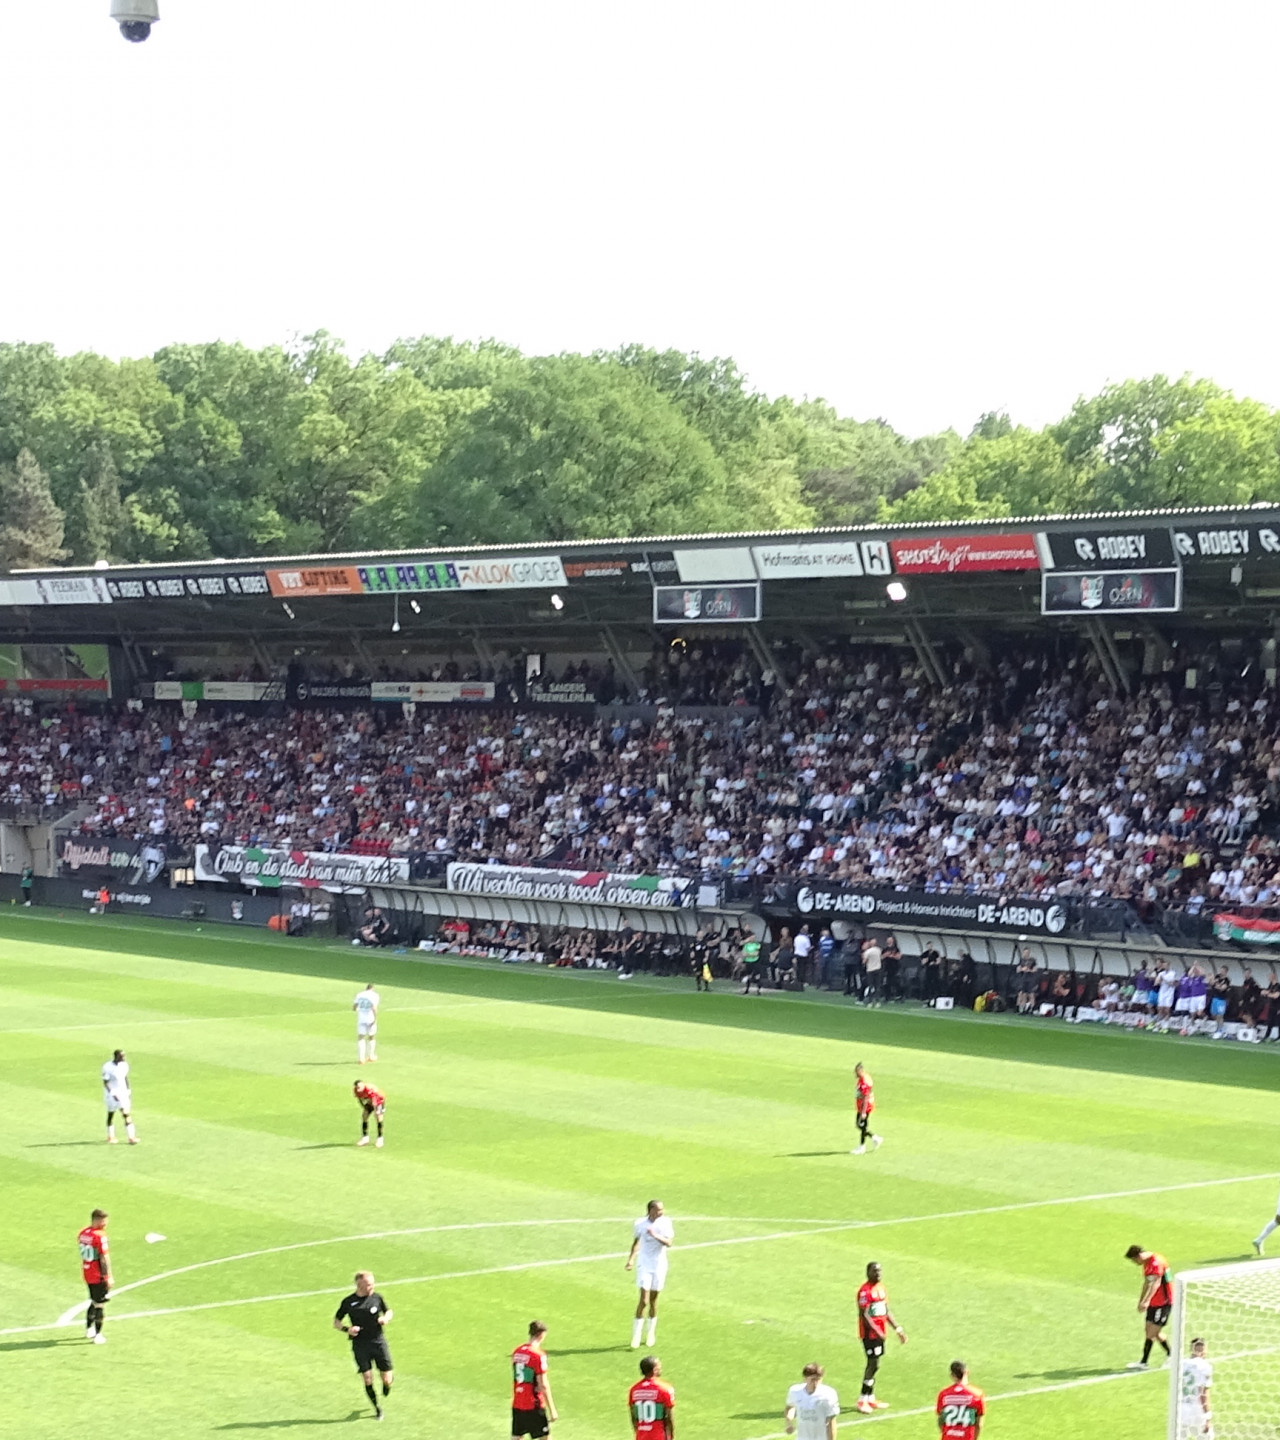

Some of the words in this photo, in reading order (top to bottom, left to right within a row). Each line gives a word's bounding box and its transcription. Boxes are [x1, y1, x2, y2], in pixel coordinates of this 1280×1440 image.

[1097, 534, 1147, 560] ROBEY
[1197, 530, 1249, 555] ROBEY
[474, 560, 560, 583] KLOKGROEP
[825, 553, 856, 566] HOME
[215, 851, 243, 874] Club
[245, 860, 261, 875] en
[263, 857, 279, 876] de
[280, 856, 309, 878] stad
[310, 866, 333, 880] van
[334, 863, 363, 883] mijn
[484, 875, 533, 898] vechten
[534, 882, 568, 898] voor
[607, 888, 650, 905] groen
[652, 891, 671, 907] en
[815, 892, 874, 913] DE-AREND
[876, 900, 903, 915] Project
[978, 904, 1044, 928] DE-AREND
[634, 1401, 656, 1423] 10
[943, 1405, 972, 1428] 24
